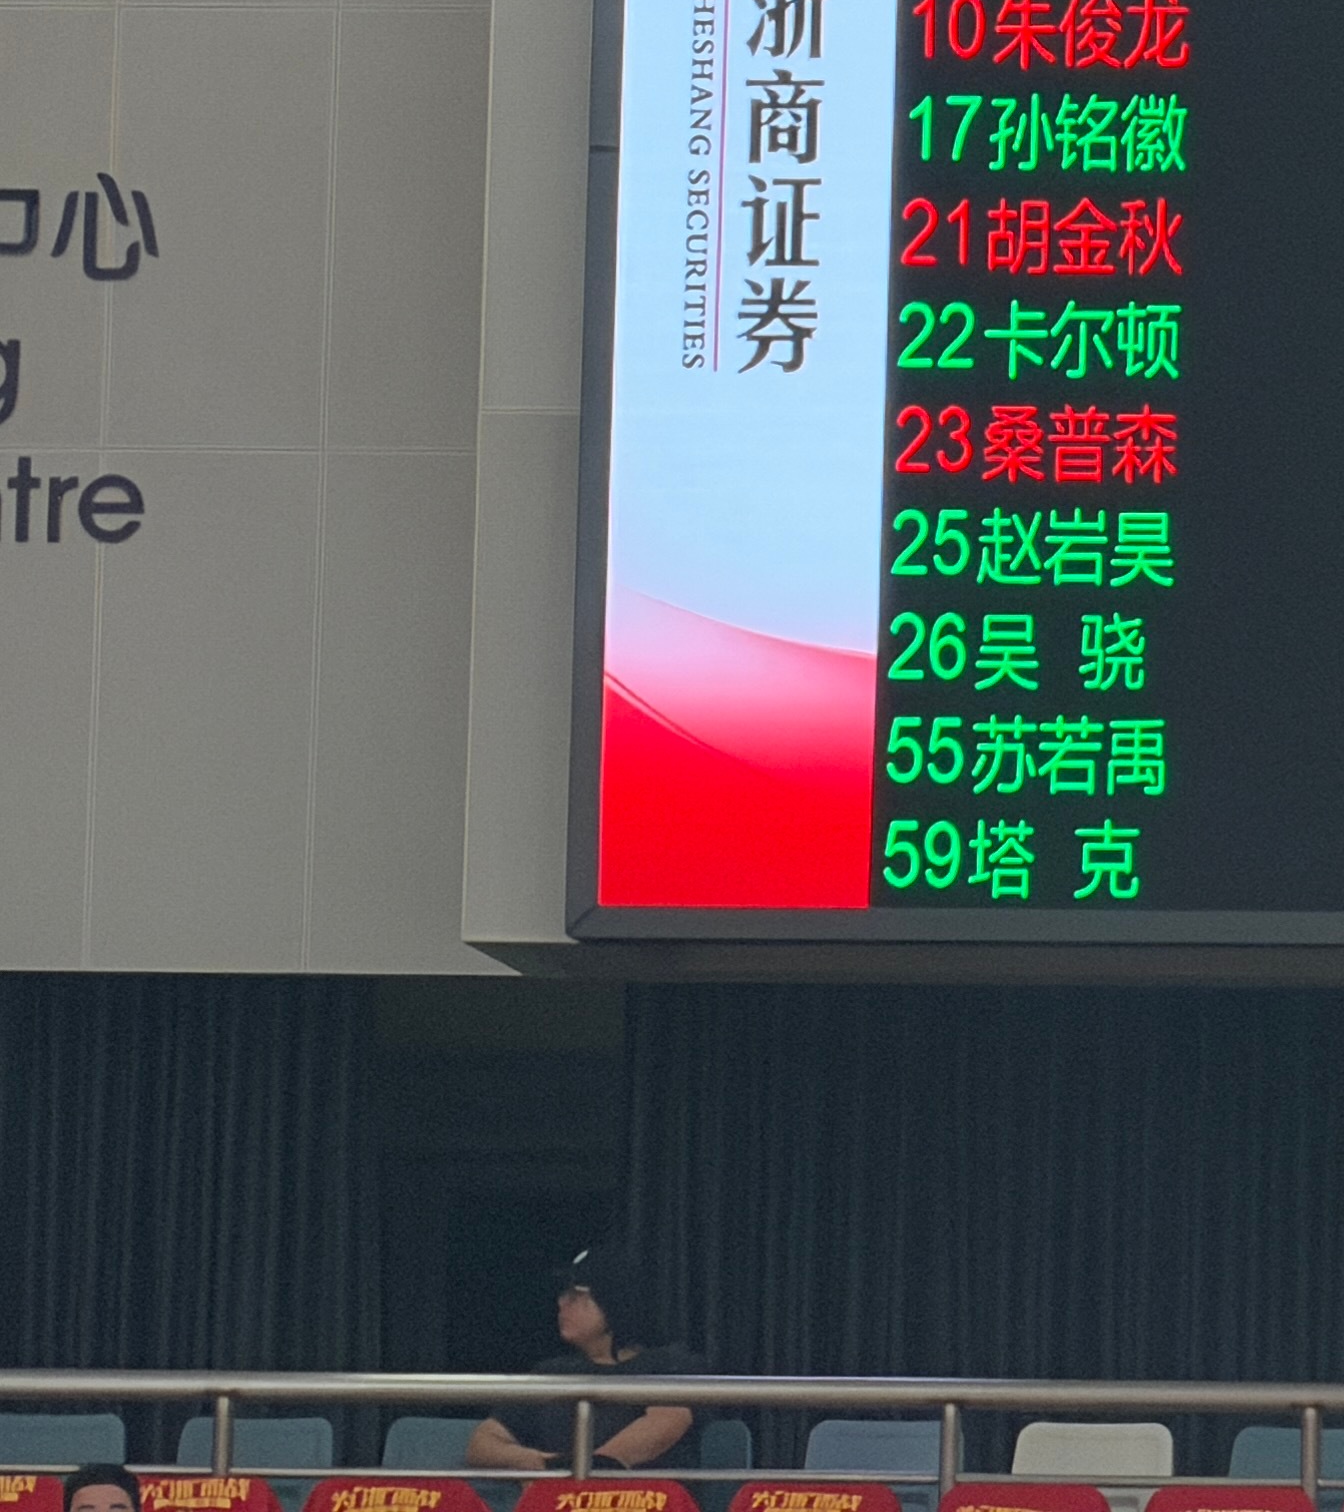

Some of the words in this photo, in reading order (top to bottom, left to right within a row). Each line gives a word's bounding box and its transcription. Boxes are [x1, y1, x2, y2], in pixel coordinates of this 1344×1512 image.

[909, 95, 982, 161] 17
[989, 93, 1187, 172] 孙铭徽
[681, 168, 711, 370] SECURITIES
[900, 197, 969, 266] 21
[987, 197, 1182, 275] 胡金秋
[897, 302, 975, 368] 22
[984, 300, 1181, 379] 卡尔顿
[895, 405, 973, 473] 23
[982, 404, 1177, 484] 桑普森
[891, 509, 970, 575] 25
[977, 507, 1174, 587] 赵岩昊
[890, 612, 966, 680] 26
[887, 717, 964, 784] 55
[972, 714, 1165, 795] 苏若禹
[883, 820, 961, 888] 59
